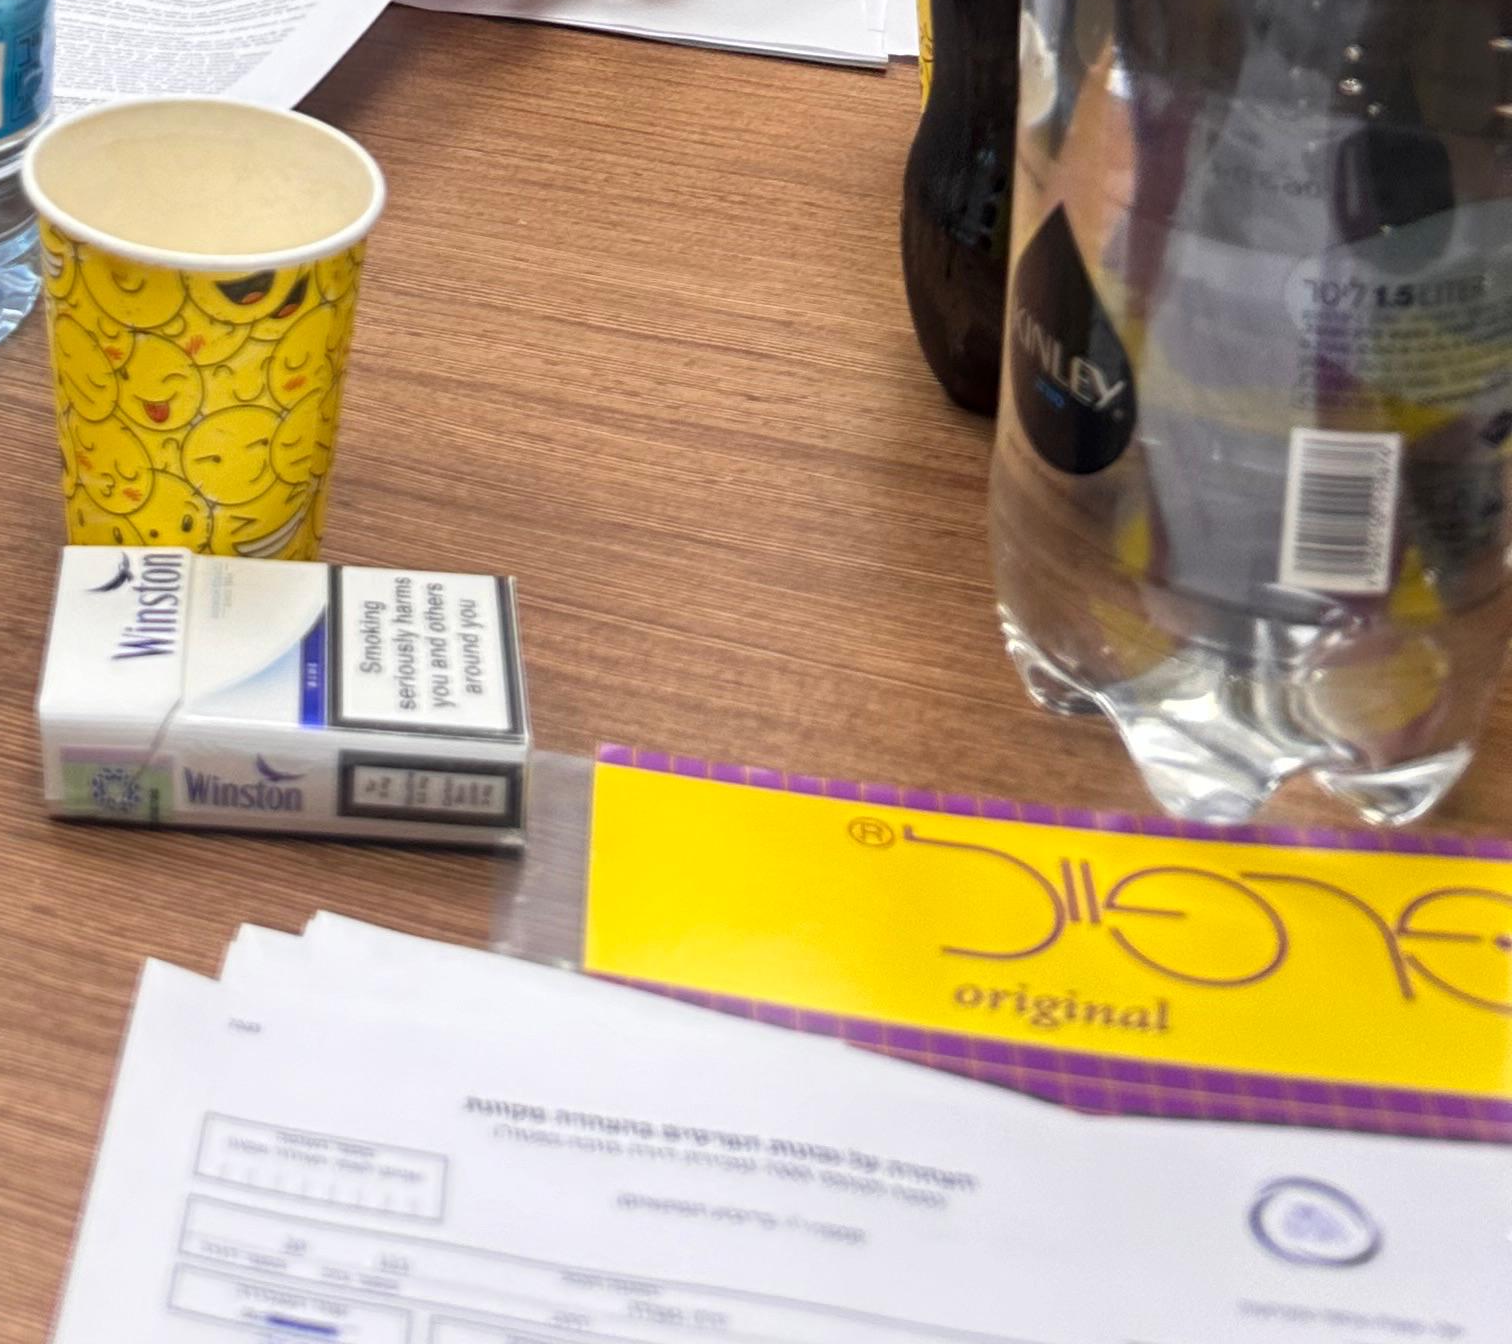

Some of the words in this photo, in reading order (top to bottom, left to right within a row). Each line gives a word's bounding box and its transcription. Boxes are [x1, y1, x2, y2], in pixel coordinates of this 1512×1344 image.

[111, 553, 183, 660] Winston
[392, 577, 413, 624] harms
[424, 583, 446, 633] others
[459, 599, 484, 628] you
[359, 600, 386, 673] Smoking
[424, 636, 448, 669] and
[392, 629, 420, 710] seriously
[457, 633, 483, 694] around
[432, 674, 456, 708] you
[184, 766, 303, 812] Winston
[953, 982, 1170, 1034] original
